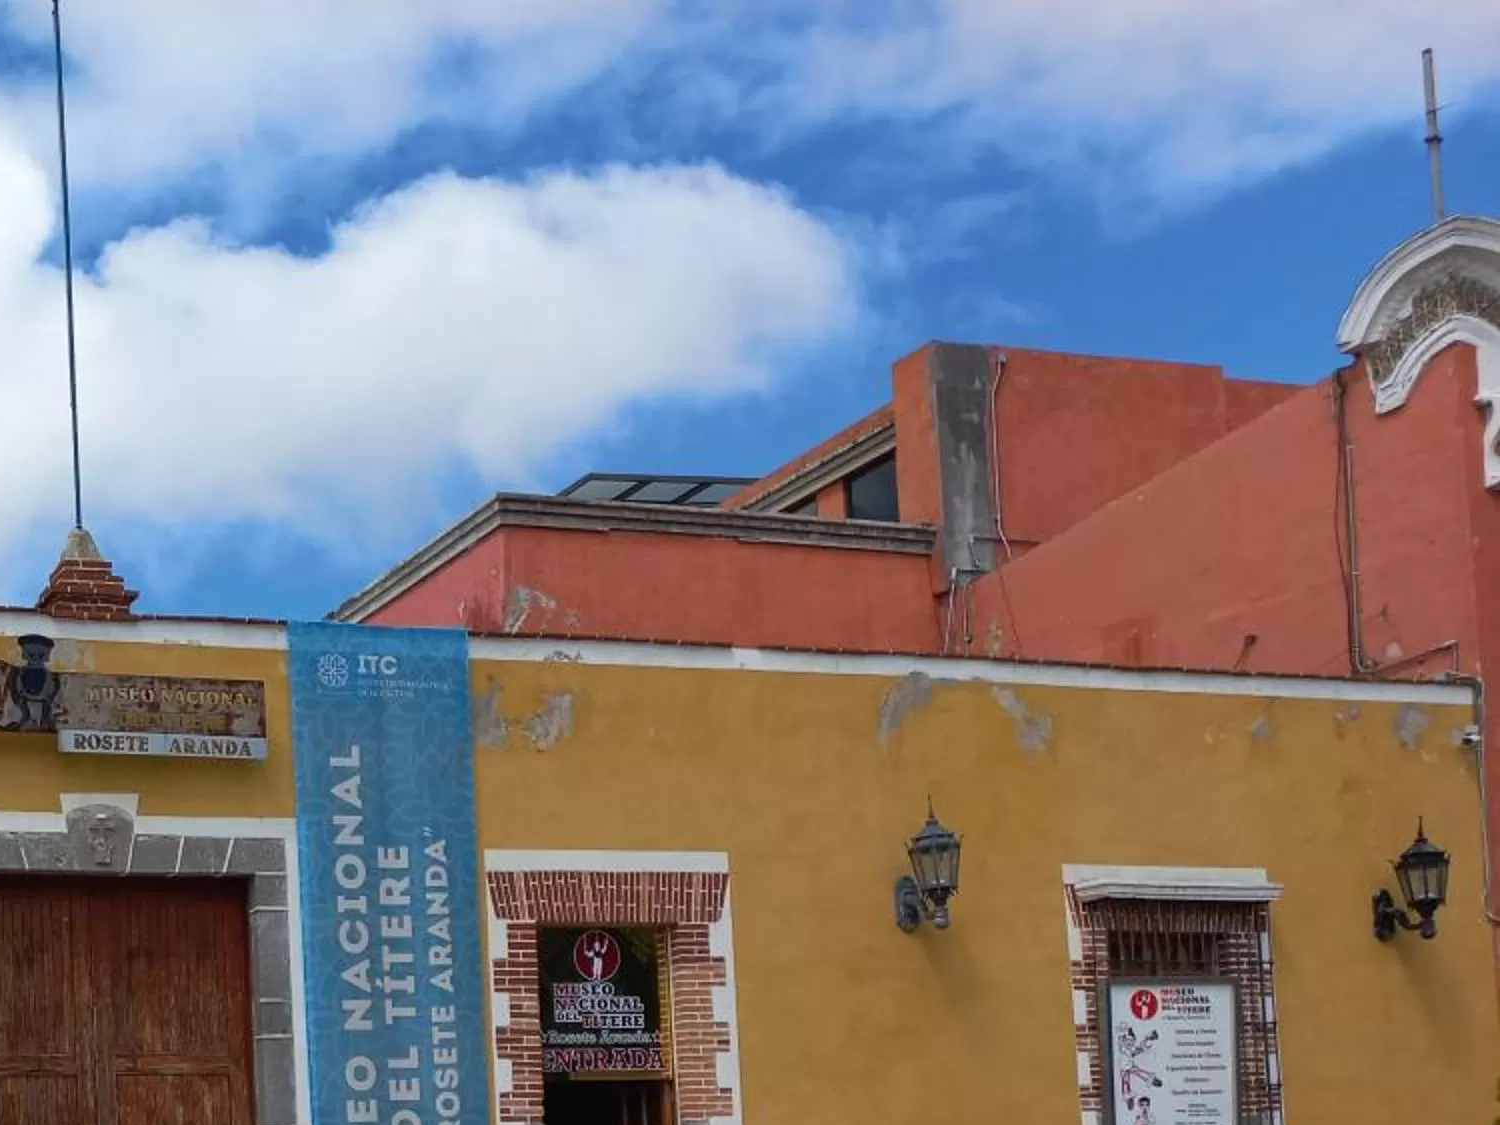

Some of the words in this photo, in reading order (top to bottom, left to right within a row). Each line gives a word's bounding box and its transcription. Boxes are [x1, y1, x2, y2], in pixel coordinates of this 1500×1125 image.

[357, 655, 398, 675] ITC
[85, 687, 155, 702] MUSEO
[73, 733, 149, 751] ROSETE
[170, 737, 254, 757] ARANDA
[330, 744, 374, 1031] NACIONAL
[377, 845, 416, 1025] TÍTERE
[553, 983, 614, 997] MUSEO
[554, 997, 644, 1012] NACIONAL
[555, 1010, 581, 1022] DEL
